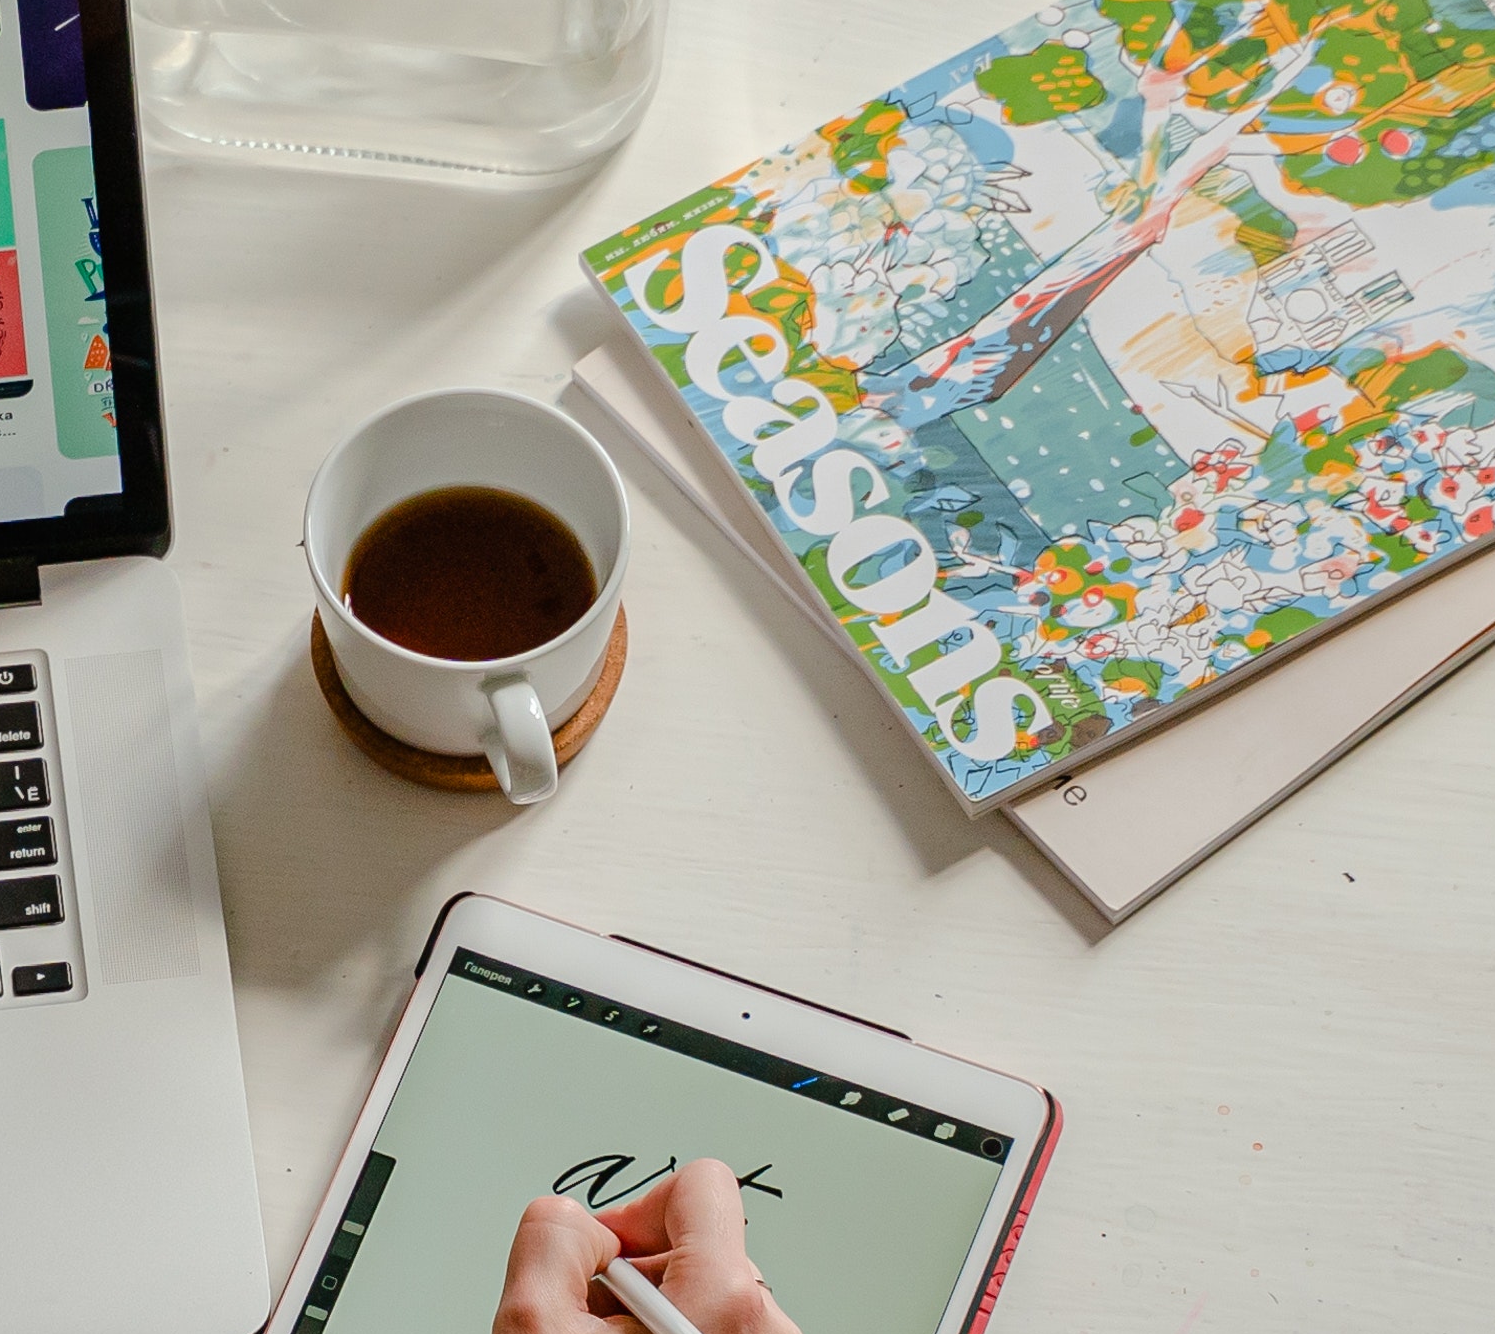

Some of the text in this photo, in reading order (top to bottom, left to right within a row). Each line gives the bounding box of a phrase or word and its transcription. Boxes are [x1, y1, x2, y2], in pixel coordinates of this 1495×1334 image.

[624, 224, 1053, 762] Seasons
[16, 823, 42, 834] enter
[10, 847, 45, 859] return
[25, 902, 51, 916] shift
[464, 961, 513, 985] Галерея
